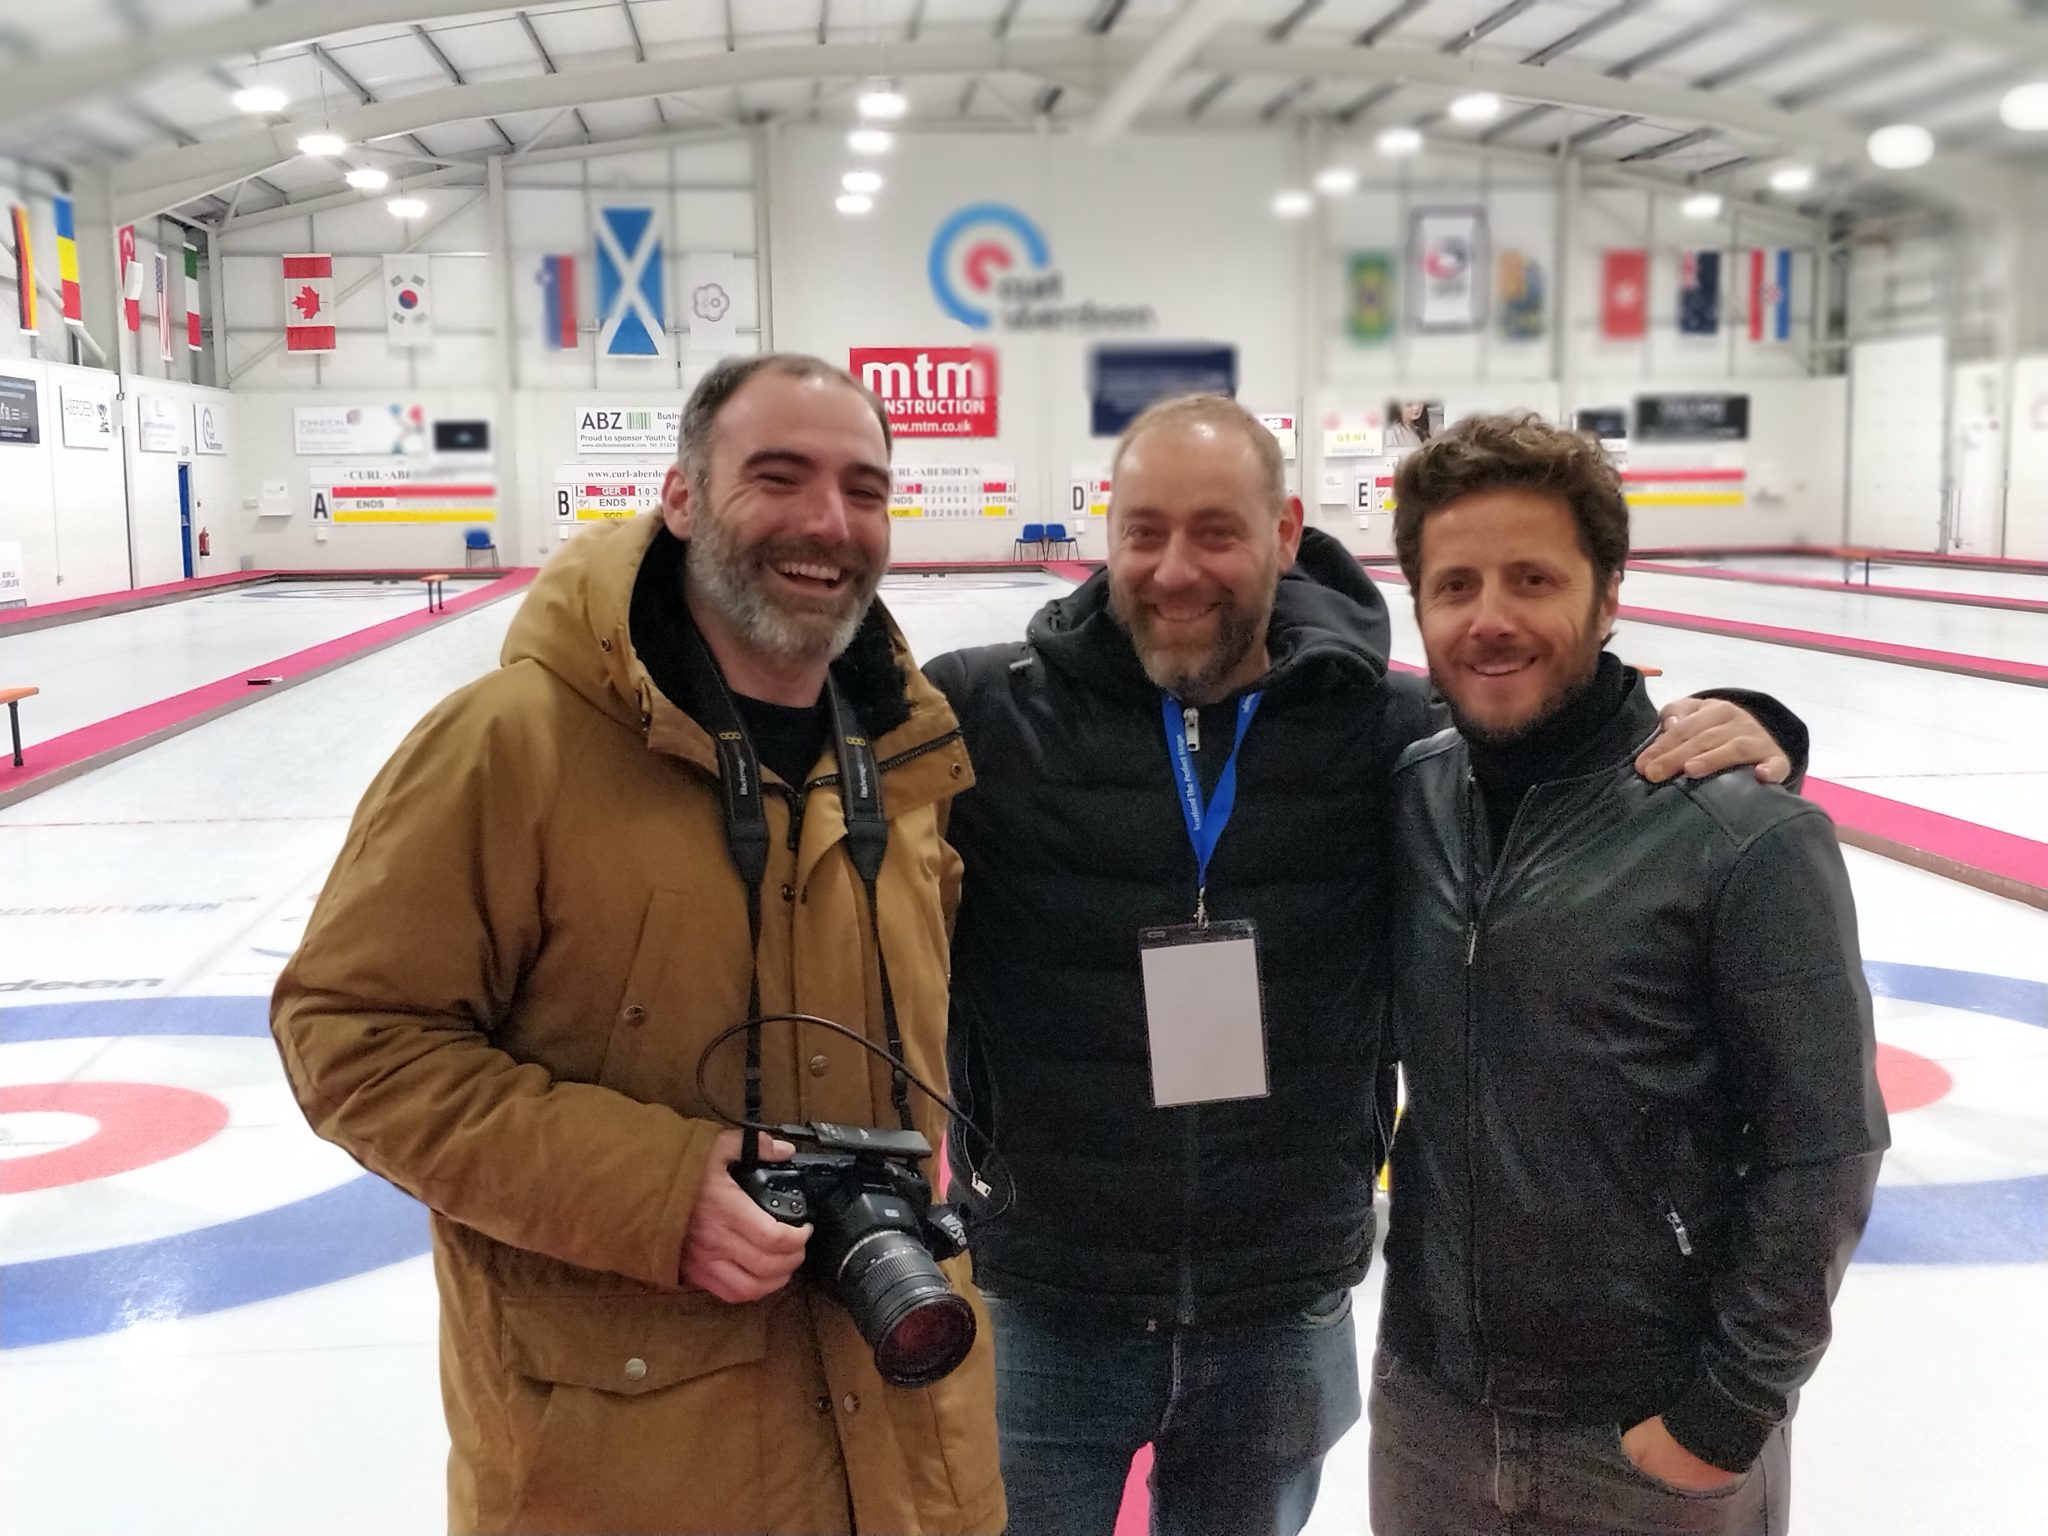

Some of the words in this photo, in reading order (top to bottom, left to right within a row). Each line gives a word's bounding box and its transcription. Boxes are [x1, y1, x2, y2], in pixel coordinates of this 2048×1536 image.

[862, 353, 985, 398] mtm
[884, 400, 985, 414] NSTRUCTION
[581, 412, 623, 430] ABZ
[890, 420, 971, 432] ww.mtm.co.uk
[587, 470, 665, 478] www.curl-aberde
[557, 490, 570, 516] B
[599, 498, 627, 507] ENDS
[1073, 486, 1084, 510] D
[1358, 482, 1368, 507] E
[313, 492, 328, 519] A
[356, 500, 384, 508] ENDS
